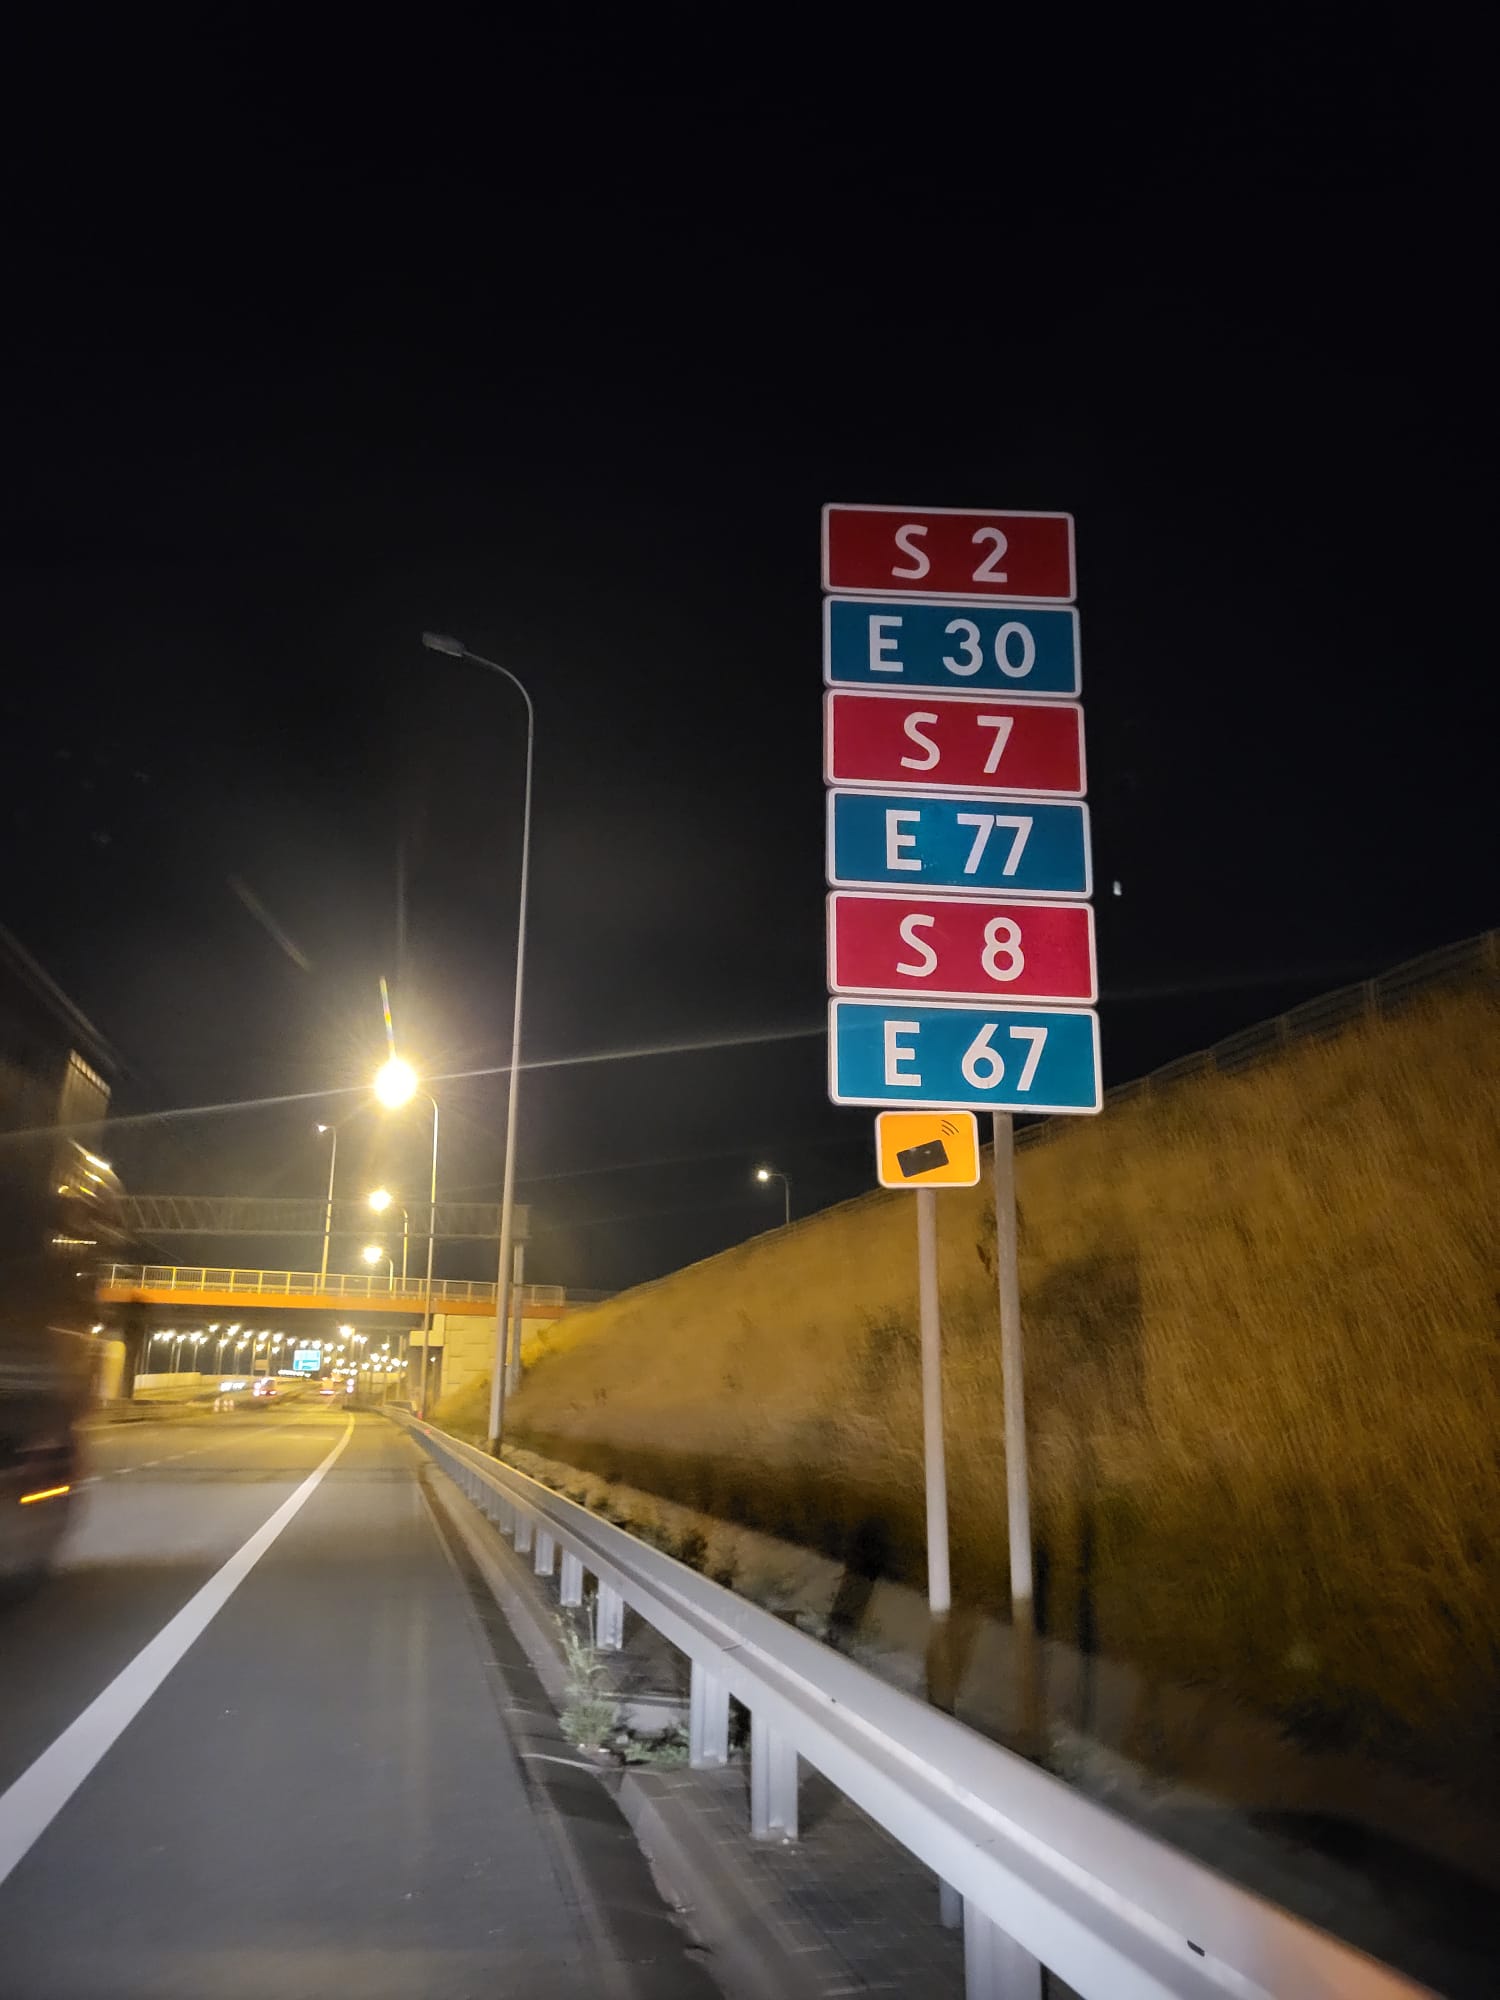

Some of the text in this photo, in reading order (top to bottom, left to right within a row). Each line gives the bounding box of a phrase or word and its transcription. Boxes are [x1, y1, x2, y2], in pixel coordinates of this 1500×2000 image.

[893, 524, 1008, 583] S 2
[869, 615, 1035, 678] E 30
[900, 712, 1014, 774] S 7
[885, 809, 1033, 875] E 77
[897, 913, 1025, 982] S 8
[884, 1020, 1048, 1091] E 67
